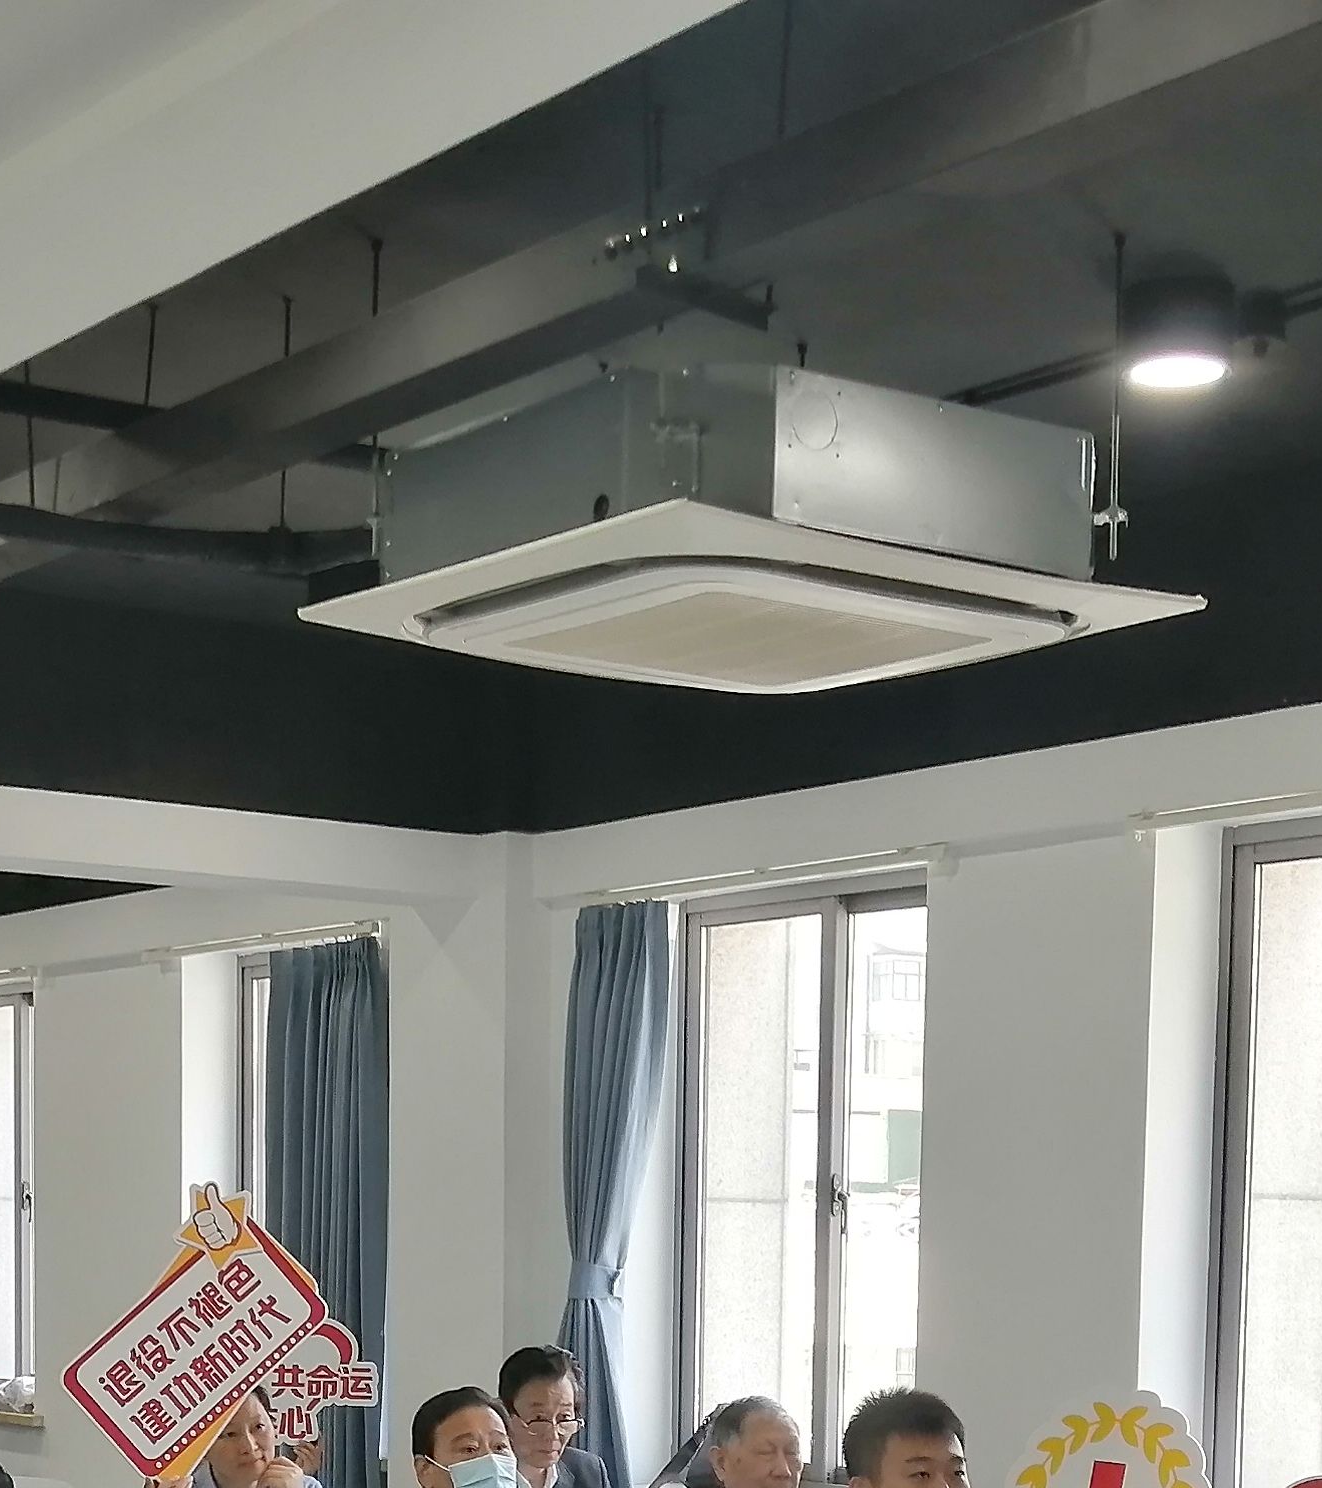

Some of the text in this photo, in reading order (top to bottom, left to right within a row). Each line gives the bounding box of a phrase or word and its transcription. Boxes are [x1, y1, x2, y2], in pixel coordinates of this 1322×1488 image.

[98, 1258, 262, 1408] 退役不褪色
[129, 1294, 292, 1445] 建功新时代
[269, 1405, 313, 1439] 心
[271, 1363, 374, 1401] 共命运
